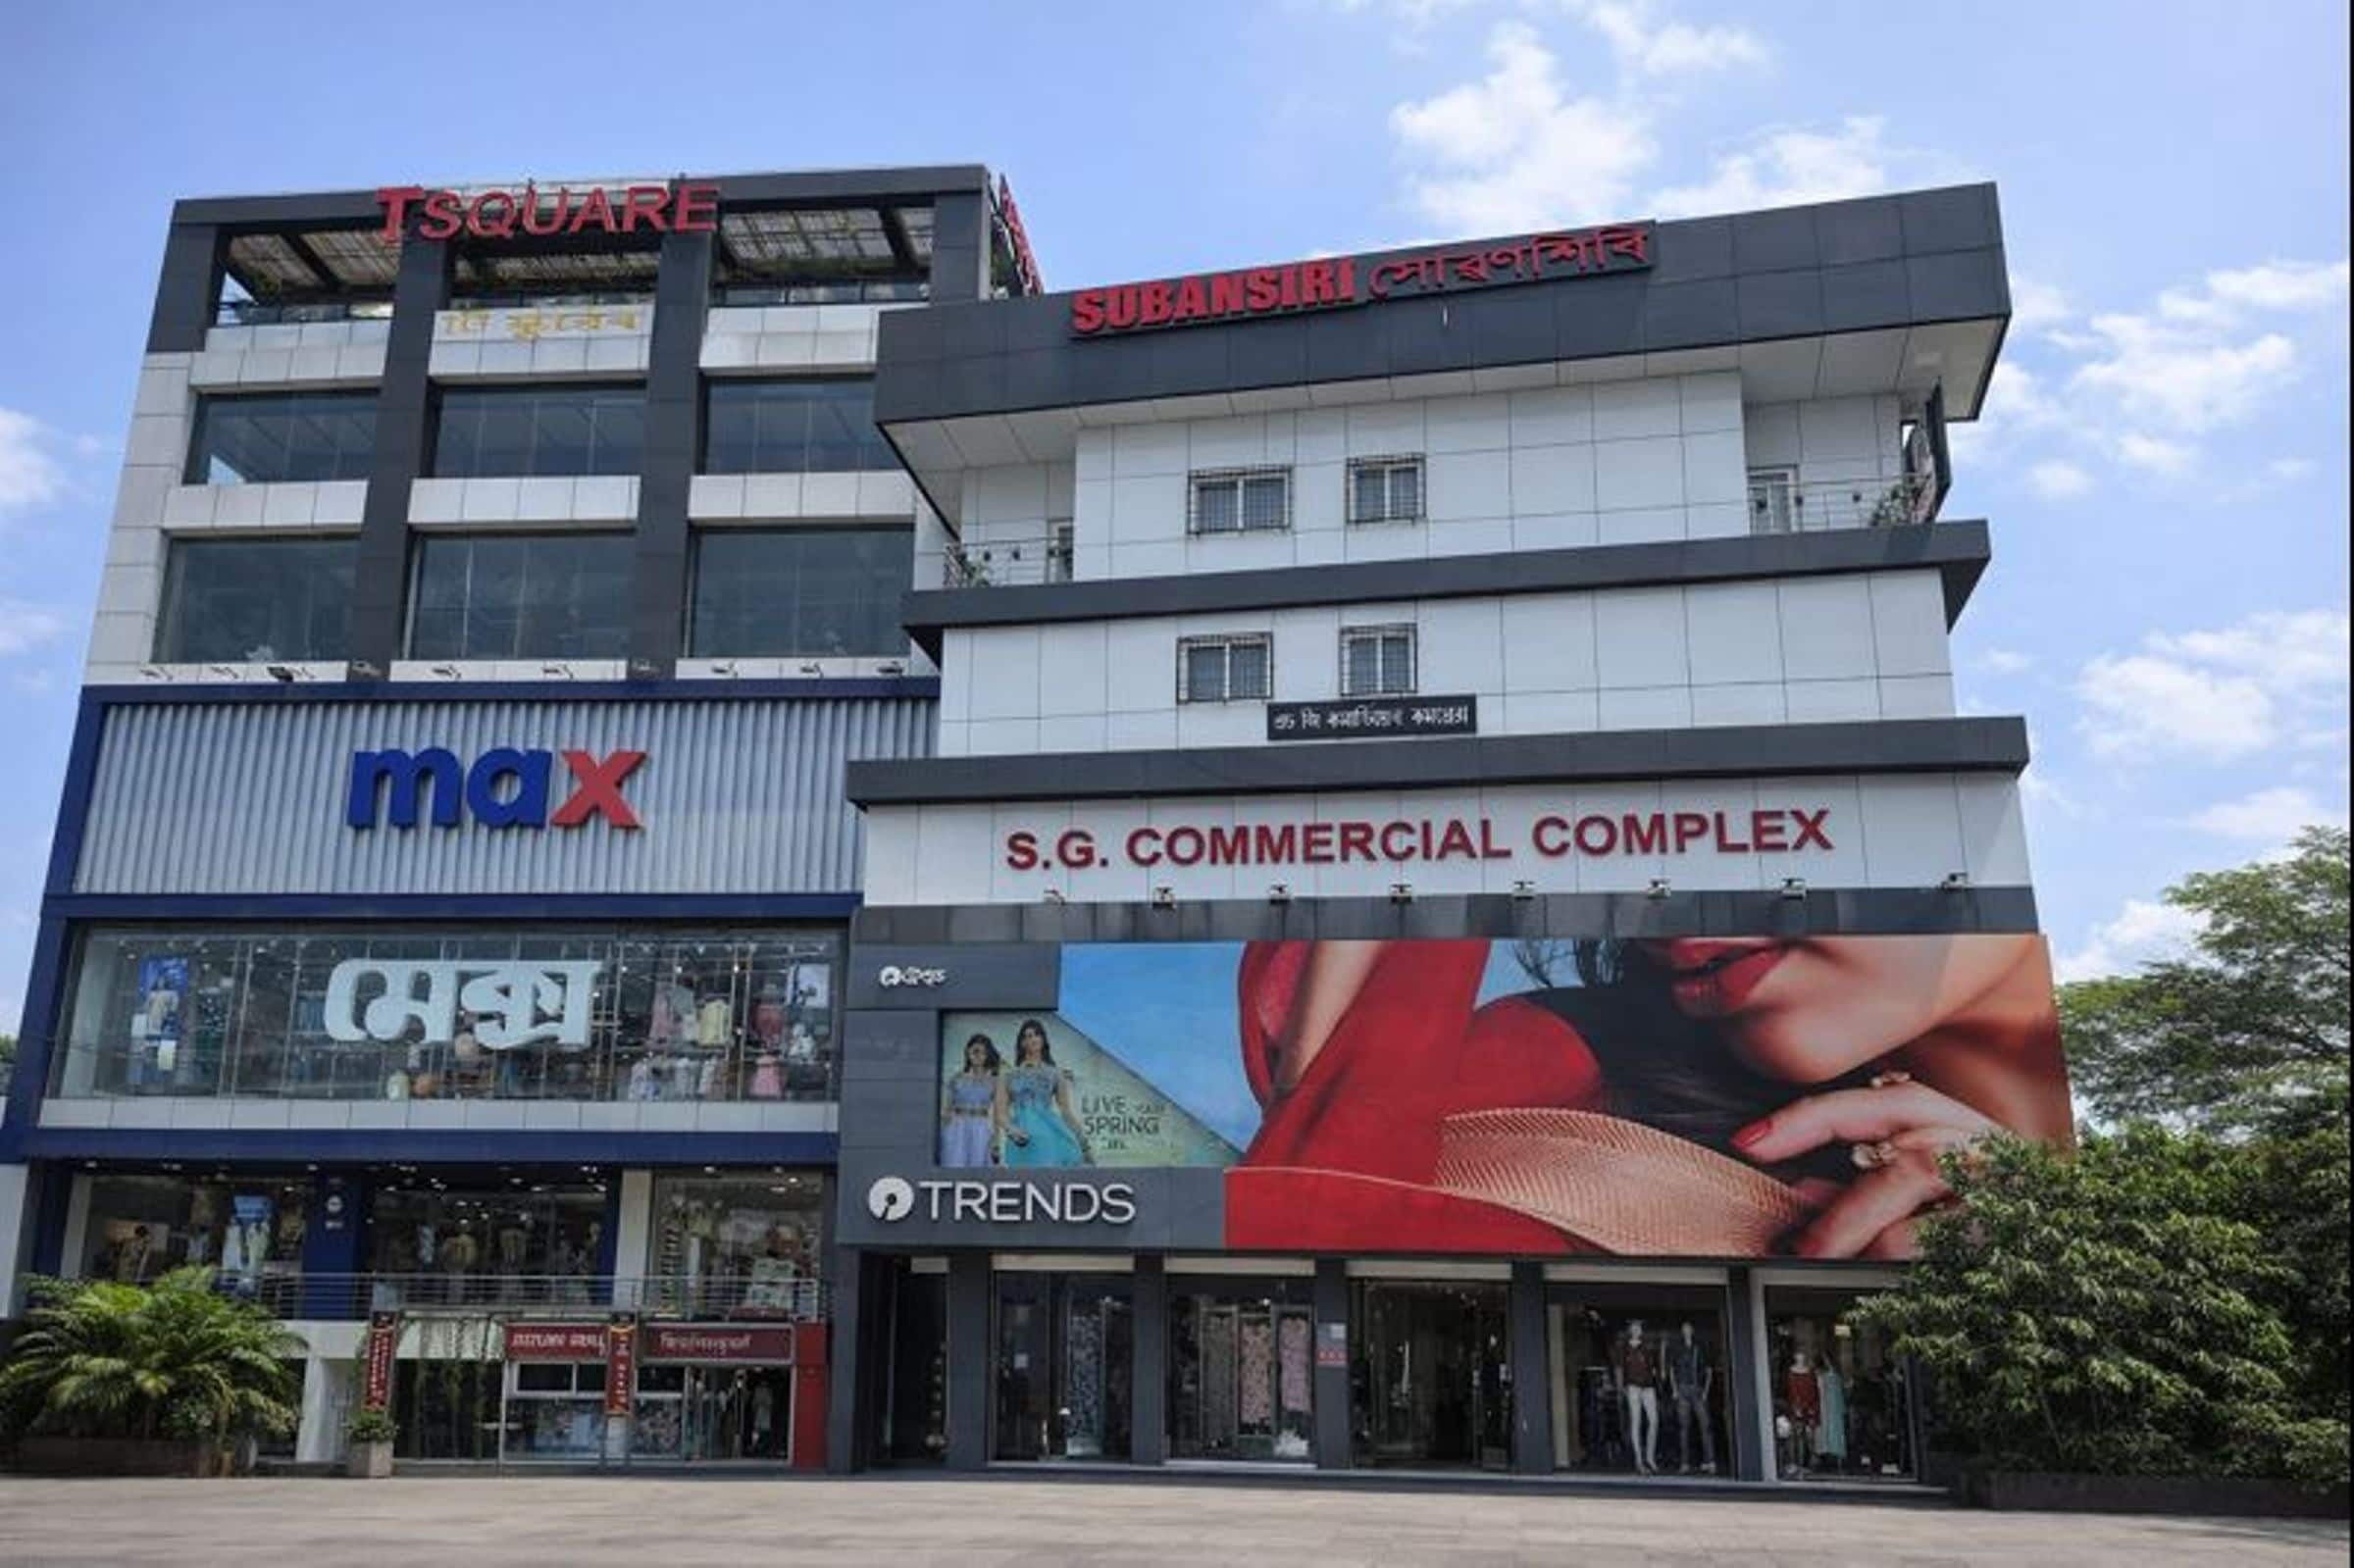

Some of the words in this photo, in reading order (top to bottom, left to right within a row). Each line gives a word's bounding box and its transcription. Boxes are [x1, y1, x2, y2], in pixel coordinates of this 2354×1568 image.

[1071, 259, 1356, 333] SUBANSIRI
[347, 746, 647, 830] max
[1006, 831, 1109, 871] S.G.
[1127, 818, 1511, 866] COMMERCIAL
[1532, 808, 1834, 856] COMPLEX
[1081, 1095, 1127, 1114] LIVE
[1084, 1115, 1160, 1135] SPRING
[919, 1181, 1136, 1223] TRENDS
